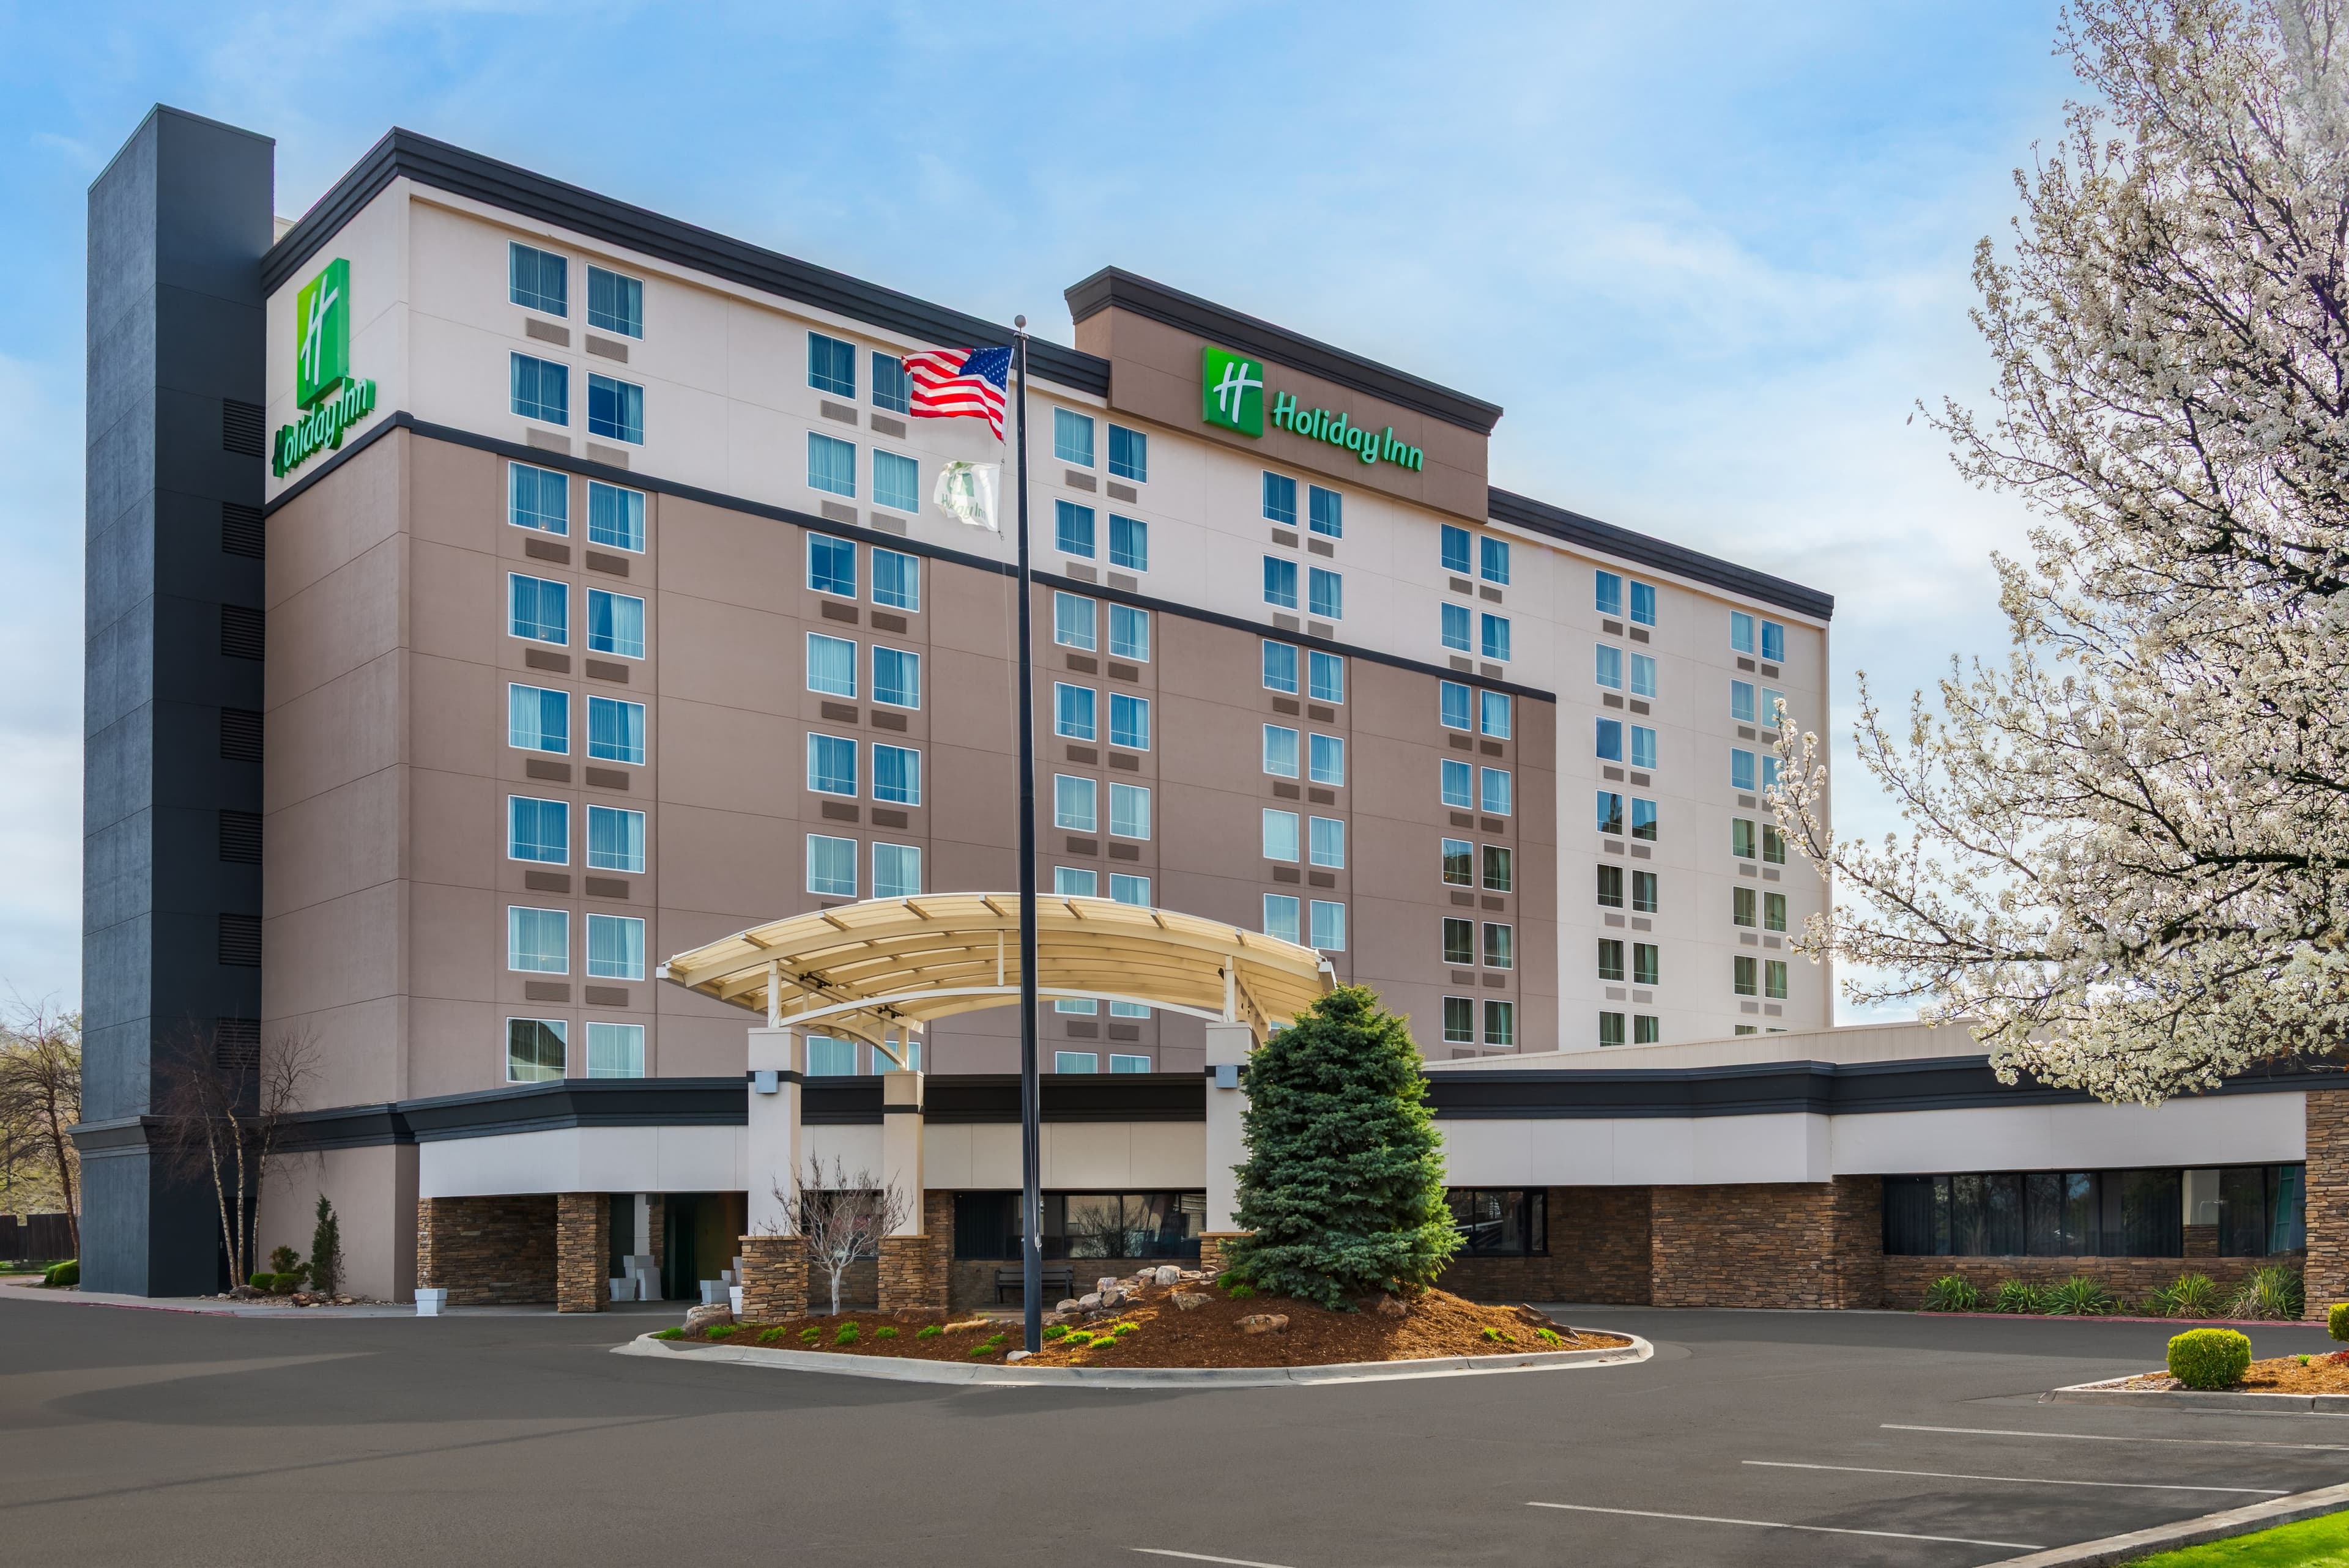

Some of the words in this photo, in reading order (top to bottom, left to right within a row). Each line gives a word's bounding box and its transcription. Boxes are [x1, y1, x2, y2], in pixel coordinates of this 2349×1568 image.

[301, 274, 338, 385] H
[339, 377, 375, 428] Inn
[1213, 362, 1263, 423] H
[1271, 391, 1379, 464] Holiday
[1381, 426, 1423, 472] Inn
